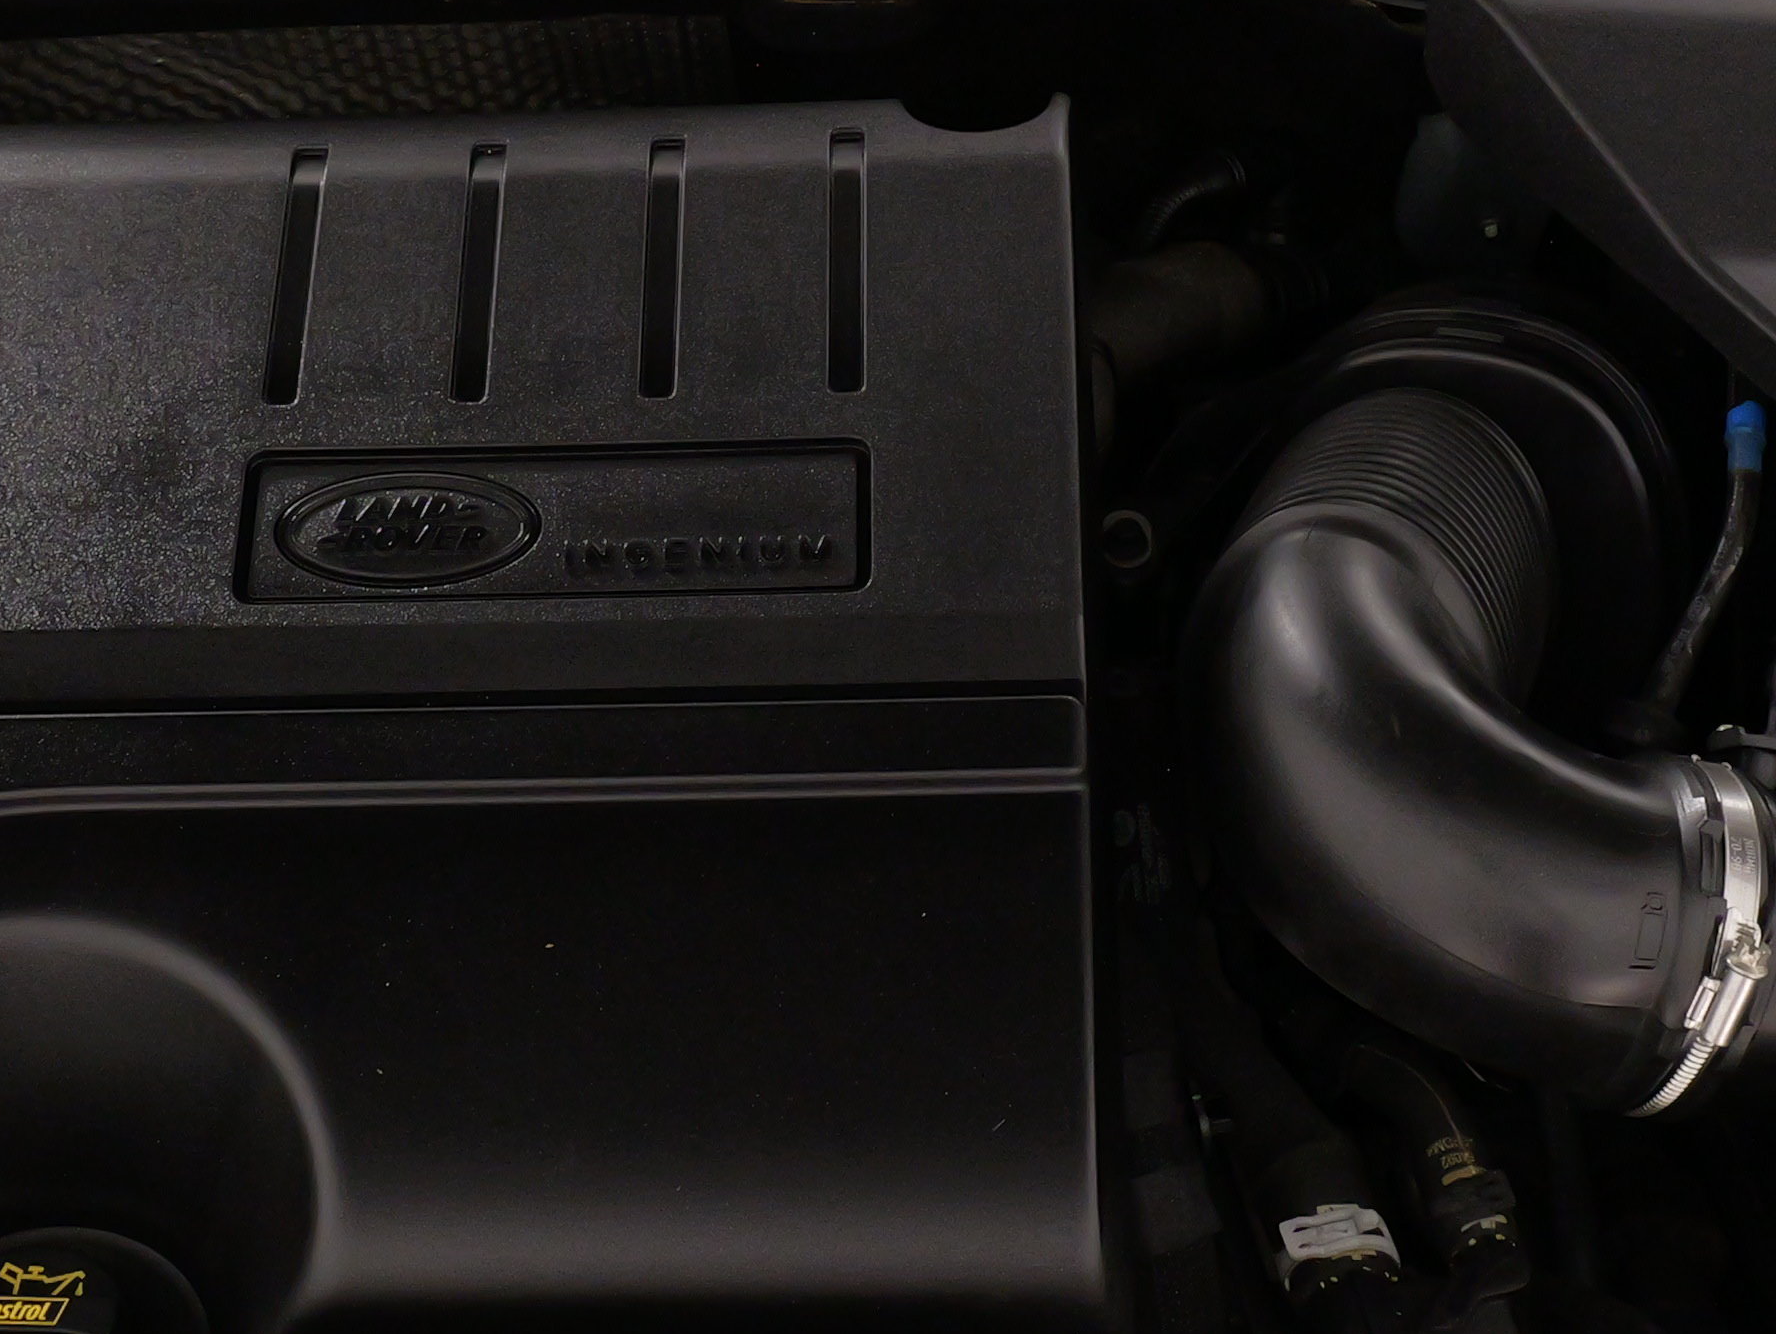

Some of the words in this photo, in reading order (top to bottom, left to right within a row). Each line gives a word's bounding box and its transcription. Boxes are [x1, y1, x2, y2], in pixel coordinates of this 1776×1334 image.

[333, 496, 454, 522] LAND
[342, 523, 489, 551] ROVER
[563, 533, 833, 569] INGENIUM
